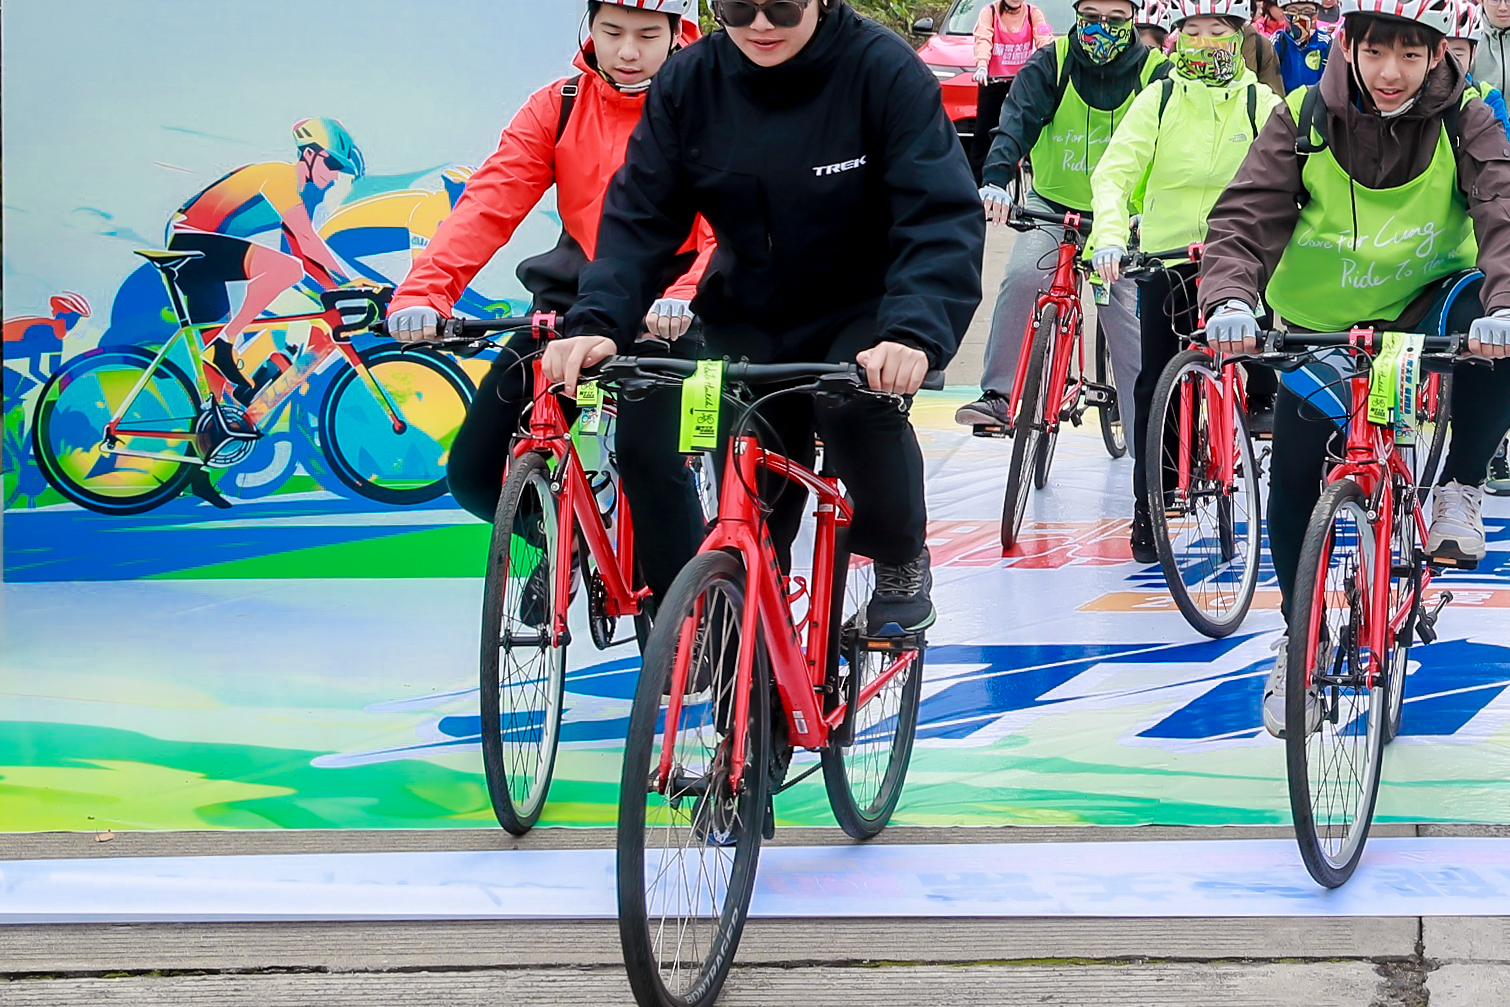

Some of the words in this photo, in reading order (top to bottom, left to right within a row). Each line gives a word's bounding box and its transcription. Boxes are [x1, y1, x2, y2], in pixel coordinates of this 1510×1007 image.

[1087, 124, 1111, 145] Lu
[811, 154, 867, 177] TREK
[1373, 215, 1446, 259] Lung
[1340, 257, 1394, 289] Ride
